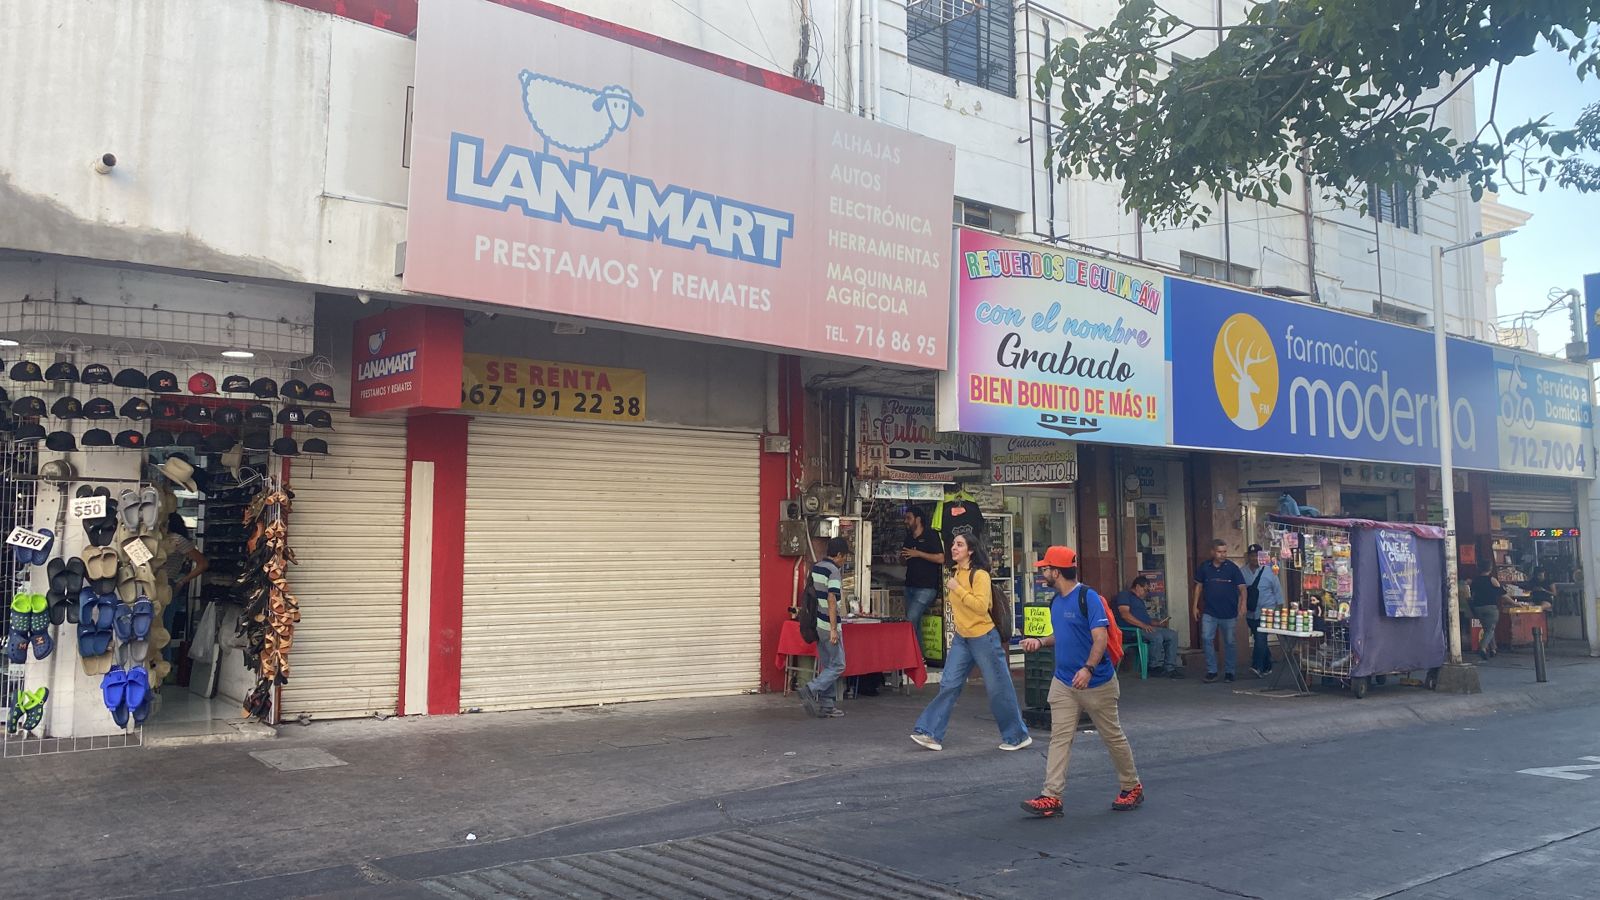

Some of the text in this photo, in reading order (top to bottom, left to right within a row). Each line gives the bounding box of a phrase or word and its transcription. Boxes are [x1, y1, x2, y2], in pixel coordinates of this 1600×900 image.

[831, 129, 901, 164] ALHAJAS
[830, 163, 881, 191] AUTOS
[452, 138, 790, 263] LANAMART
[829, 195, 933, 236] ELECTRÓNICA
[828, 229, 940, 269] HERRAMIENTAS
[474, 234, 771, 312] PRESTAMOS Y REMATES
[826, 262, 928, 297] MAQUINARIA
[964, 248, 1161, 315] RECUERDOS DE CULIACÁN
[826, 285, 908, 316] AGRÍCOLA
[975, 300, 1151, 348] con el nombre
[825, 324, 936, 356] TEL. 716 86 95
[1285, 324, 1378, 374] farmacias
[358, 350, 417, 381] LANAMART
[996, 332, 1135, 382] Grabado
[360, 381, 412, 399] PRESTAMOS Y REMATES
[486, 361, 612, 392] SE RENTA
[1536, 373, 1588, 402] Servicio a
[516, 388, 560, 410] 191
[573, 392, 602, 414] 22
[612, 395, 641, 417] 38
[970, 374, 1013, 405] BIEN
[1018, 381, 1080, 412] BONITO
[1084, 388, 1105, 414] DE
[1109, 389, 1143, 419] MÁS
[1260, 403, 1270, 415] FM
[1040, 413, 1098, 427] DEN
[889, 447, 954, 461] DEN
[1509, 436, 1586, 472] 712.7004
[1005, 464, 1027, 482] BIEN
[1028, 462, 1065, 481] BONITO
[74, 504, 101, 518] $50
[12, 533, 42, 547] $100
